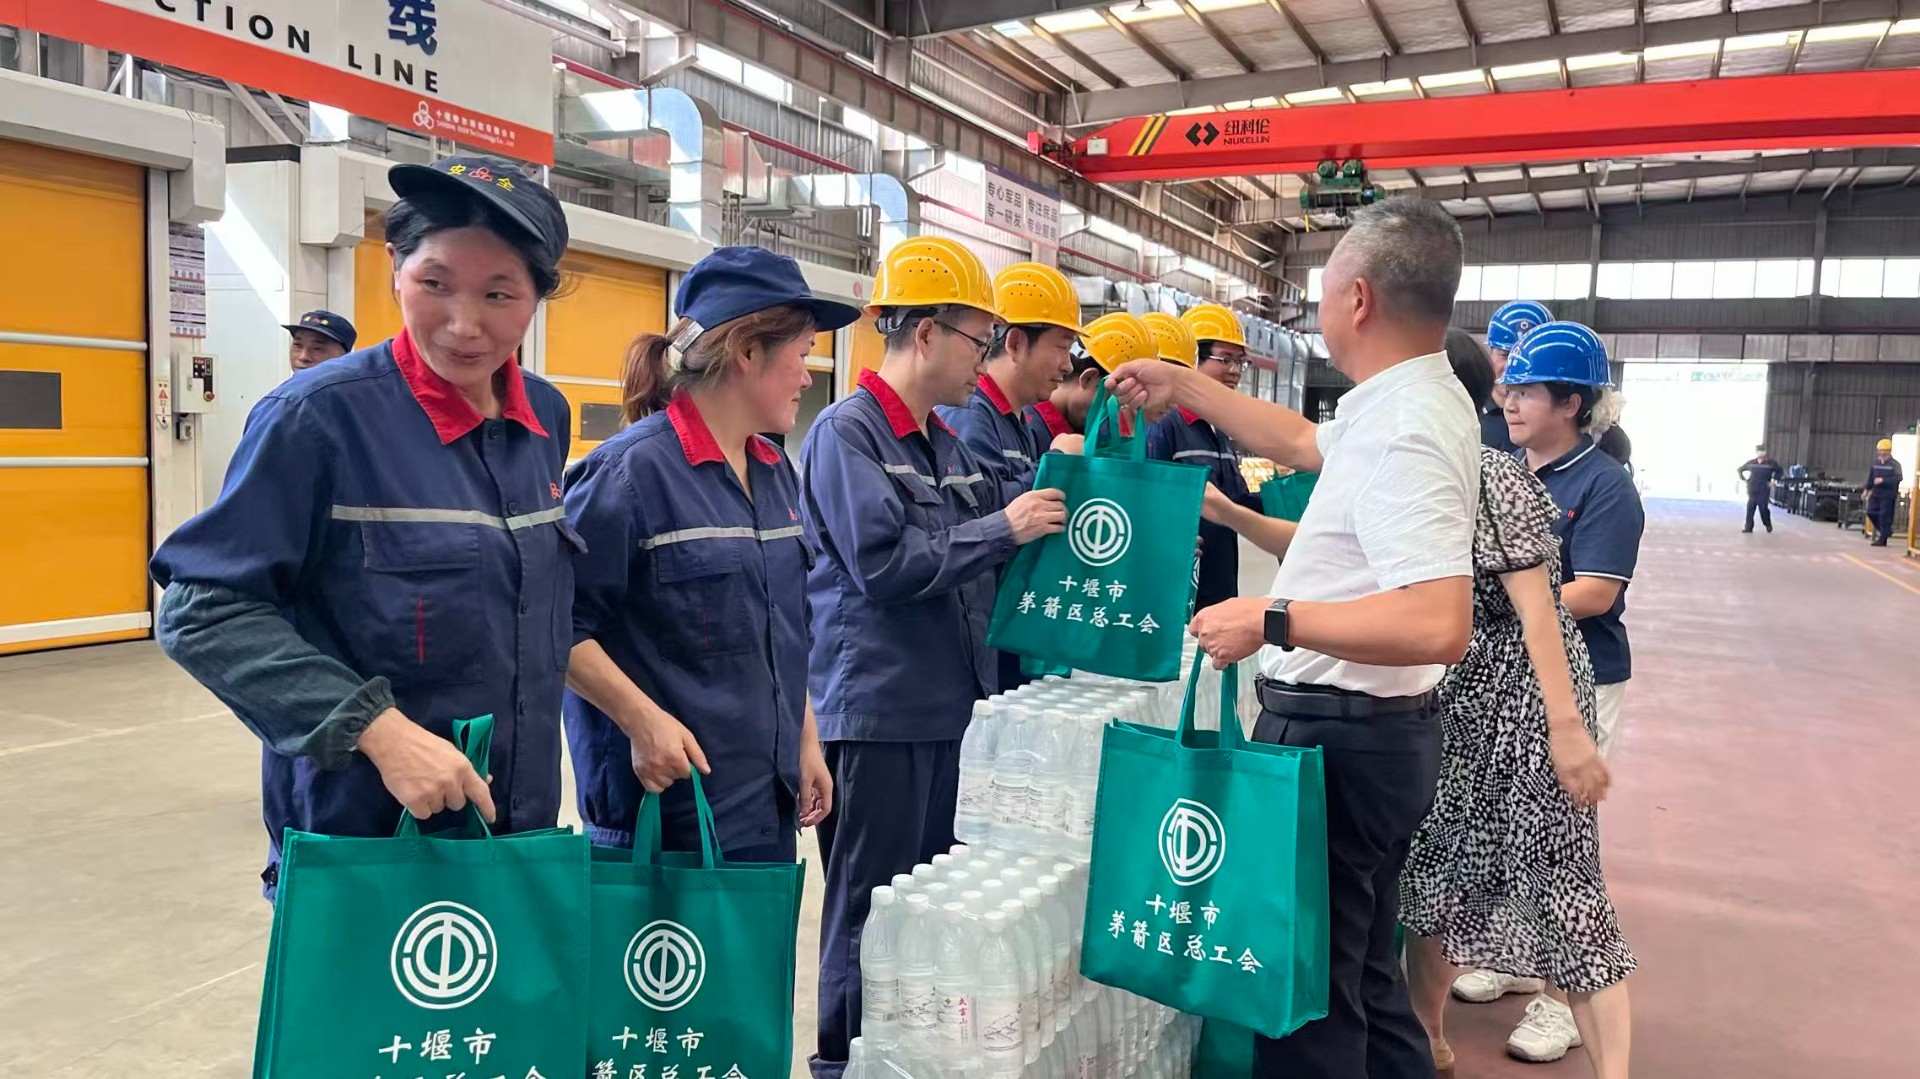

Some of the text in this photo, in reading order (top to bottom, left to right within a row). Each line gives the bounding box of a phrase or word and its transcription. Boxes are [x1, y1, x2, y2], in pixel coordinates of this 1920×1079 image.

[388, 0, 438, 55] 线
[347, 44, 438, 94] LINE
[1223, 135, 1270, 145] NIUKELUN
[1224, 118, 1270, 135] 纽科伦
[1058, 575, 1127, 603] 十堰市
[1016, 591, 1160, 634] 茅箭区总工会
[1145, 893, 1220, 931] 十堰市
[1107, 909, 1264, 974] 茅箭区总工会
[378, 1027, 497, 1064] 十堰市
[611, 1026, 704, 1057] 十堰市
